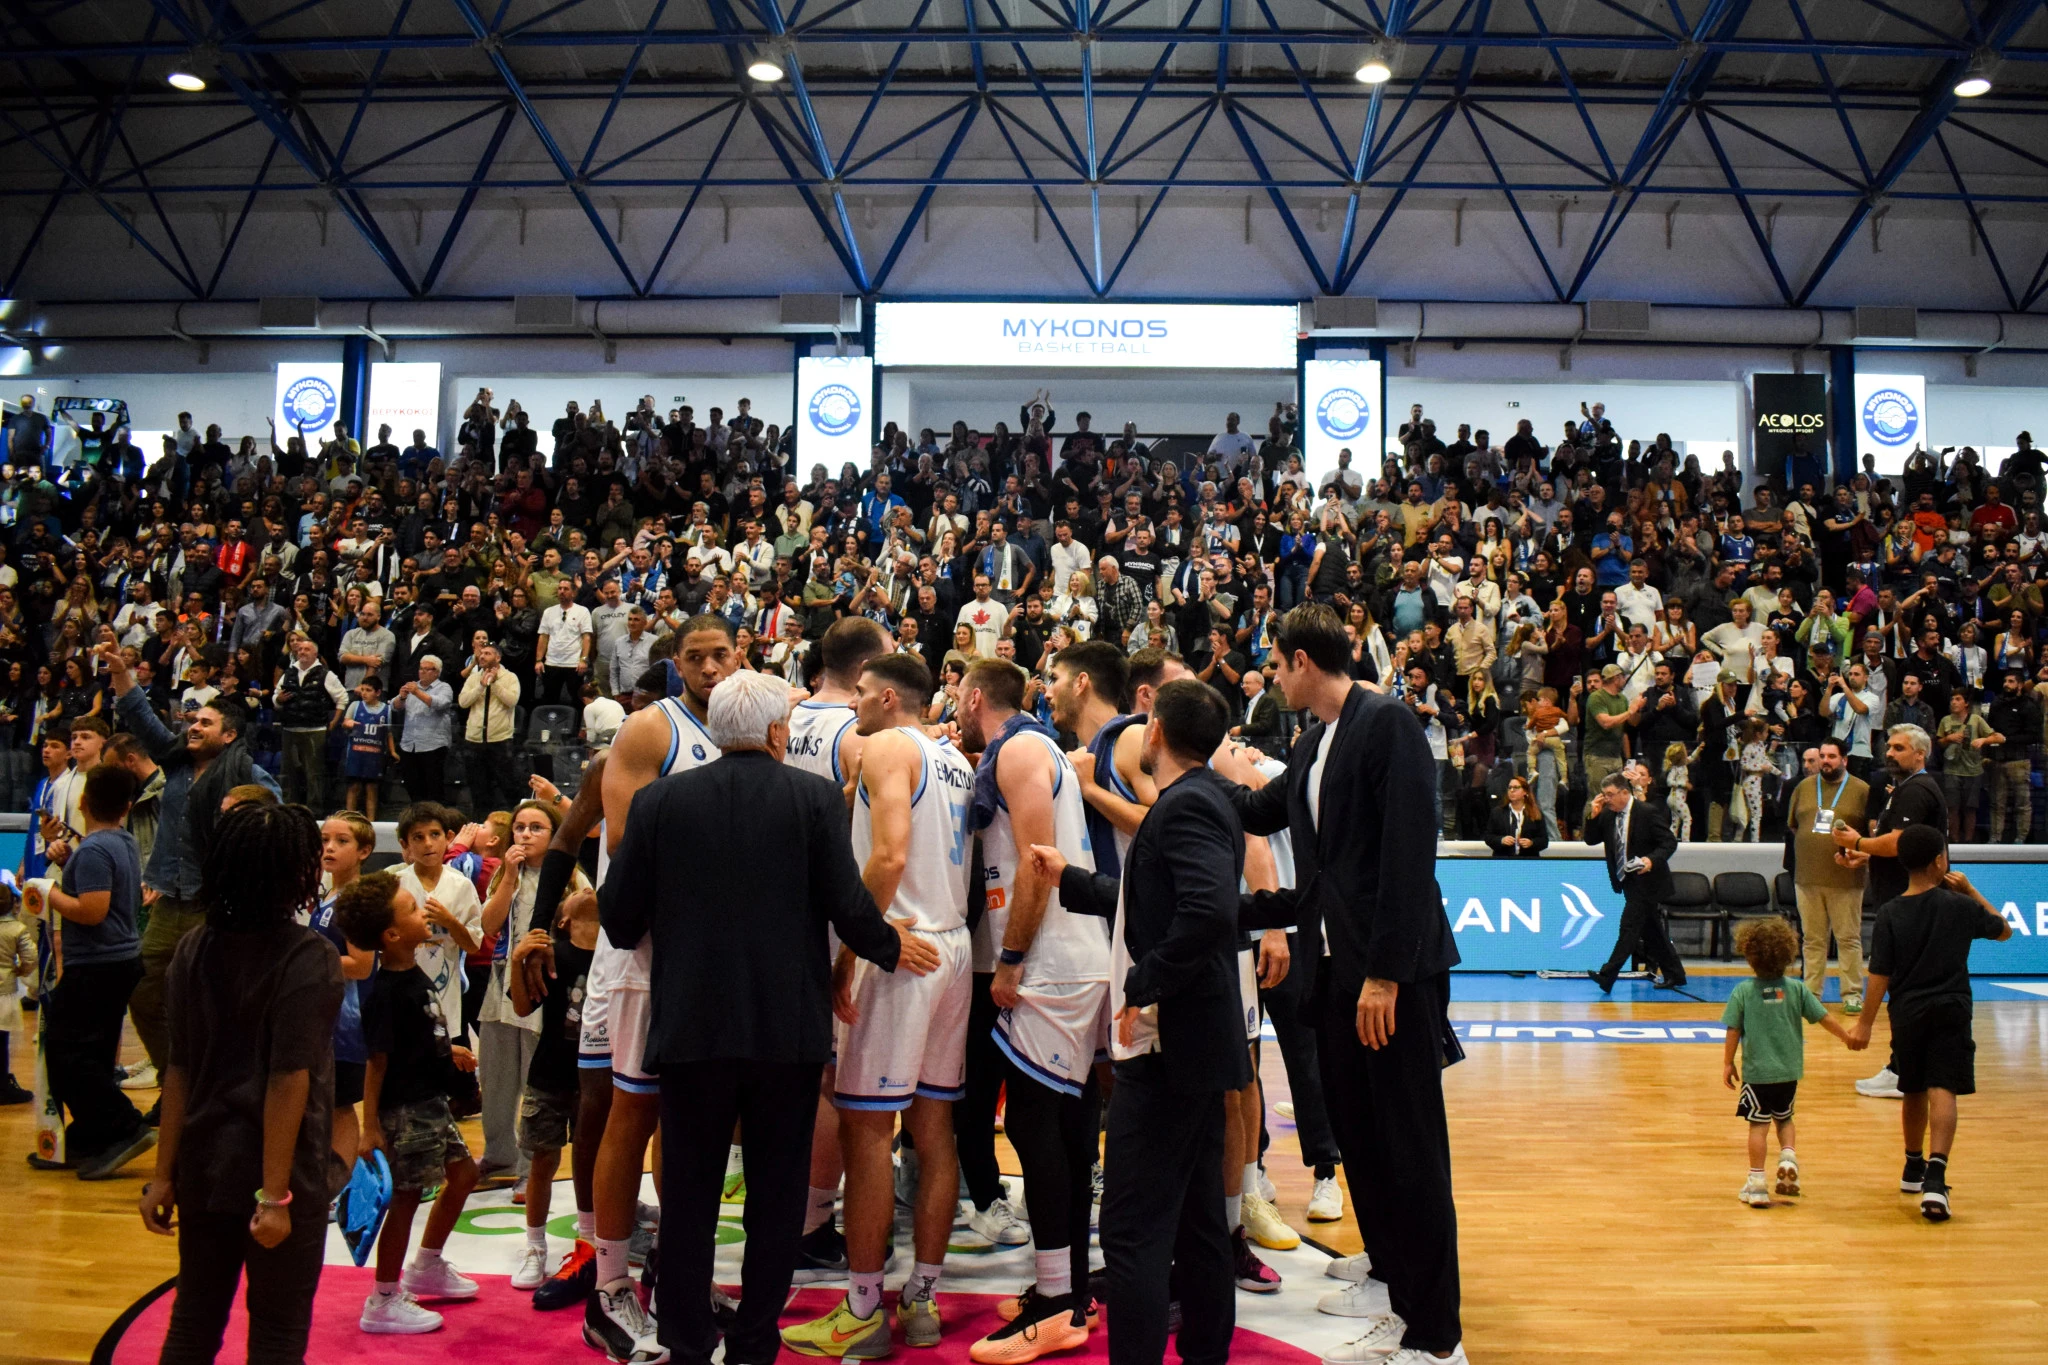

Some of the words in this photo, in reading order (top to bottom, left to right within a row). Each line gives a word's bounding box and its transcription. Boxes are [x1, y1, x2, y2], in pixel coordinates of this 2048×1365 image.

[1002, 318, 1168, 338] MYKONOS
[1018, 341, 1152, 354] BASKETBALL
[287, 379, 333, 400] MYKONOS
[812, 386, 858, 405] MYKONOS
[1866, 391, 1914, 412] MYKONOS
[1758, 413, 1824, 427] AEOLOS
[600, 612, 626, 620] OAKLEY
[1443, 898, 1541, 933] AN
